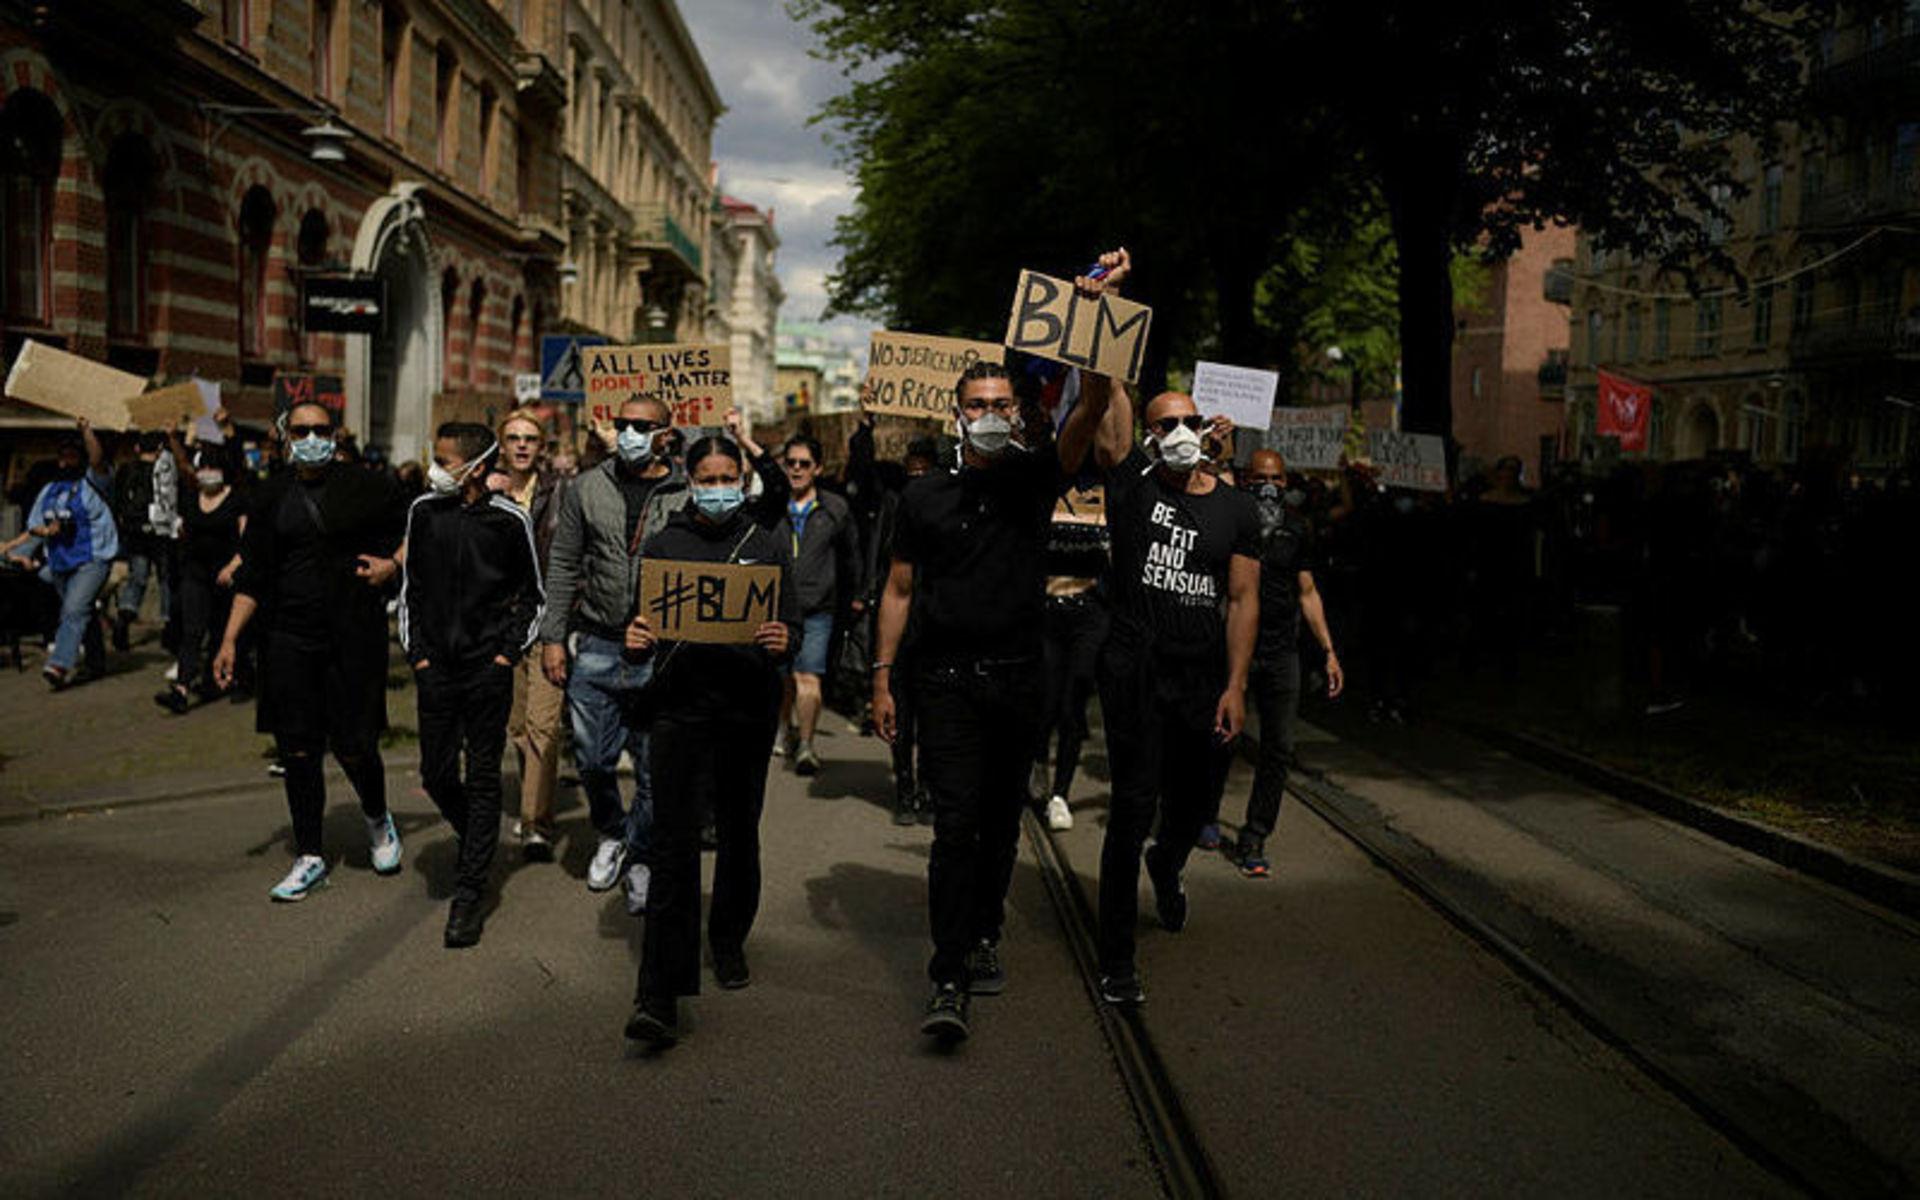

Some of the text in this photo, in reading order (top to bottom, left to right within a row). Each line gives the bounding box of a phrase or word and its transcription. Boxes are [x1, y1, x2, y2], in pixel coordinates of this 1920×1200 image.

[1013, 273, 1149, 379] BLM
[592, 350, 710, 373] ALL LIVES
[871, 340, 893, 366] NO
[659, 371, 730, 389] MATTER
[1151, 500, 1177, 528] BE
[1170, 525, 1198, 551] FIT
[1146, 541, 1185, 570] AND
[1141, 563, 1217, 598] SENSUAL
[650, 569, 775, 630] #BLM
